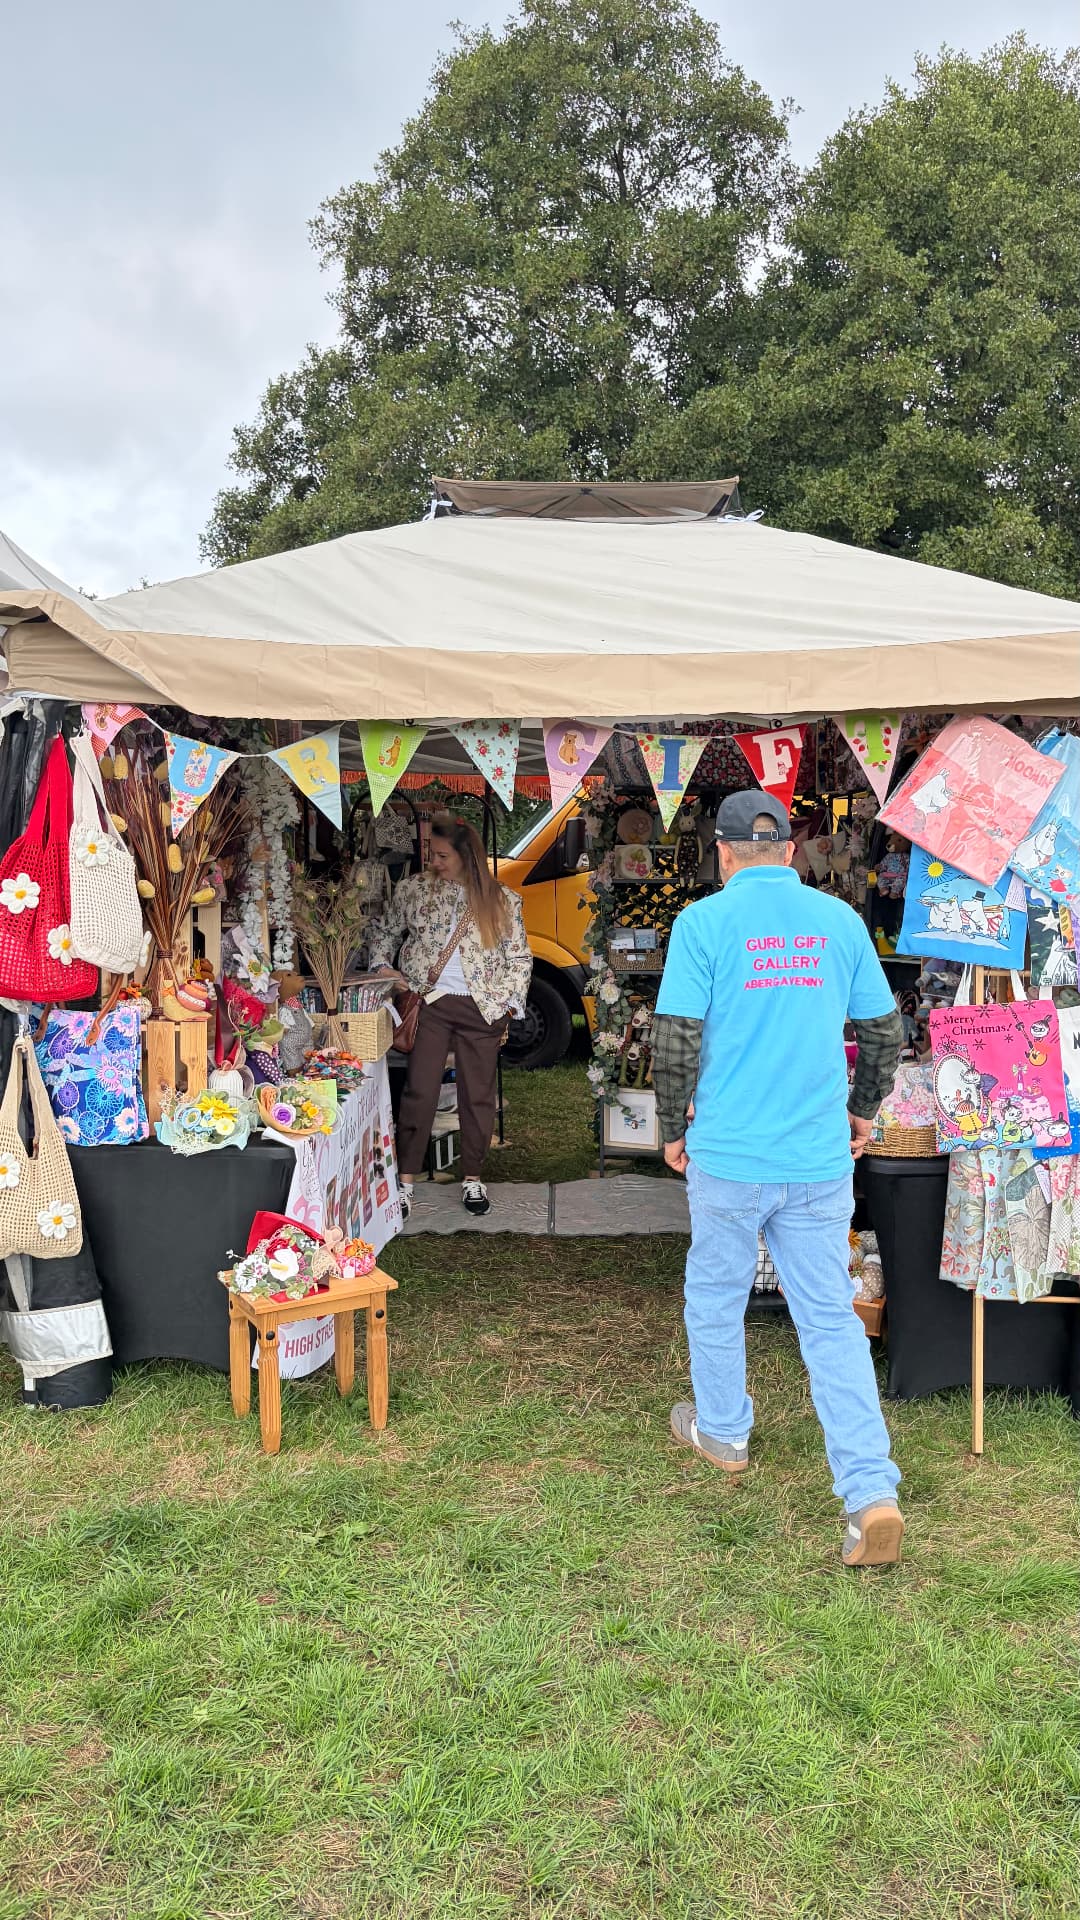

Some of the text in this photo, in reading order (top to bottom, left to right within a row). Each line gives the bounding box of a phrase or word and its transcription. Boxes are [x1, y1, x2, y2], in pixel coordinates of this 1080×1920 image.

[746, 936, 828, 951] GURU GIFT
[753, 956, 821, 971] GALLERY
[744, 976, 824, 990] ABERGAVENNY
[943, 1016, 975, 1025] Merry
[952, 1023, 1012, 1036] Christmas!
[284, 1333, 314, 1358] HIGH
